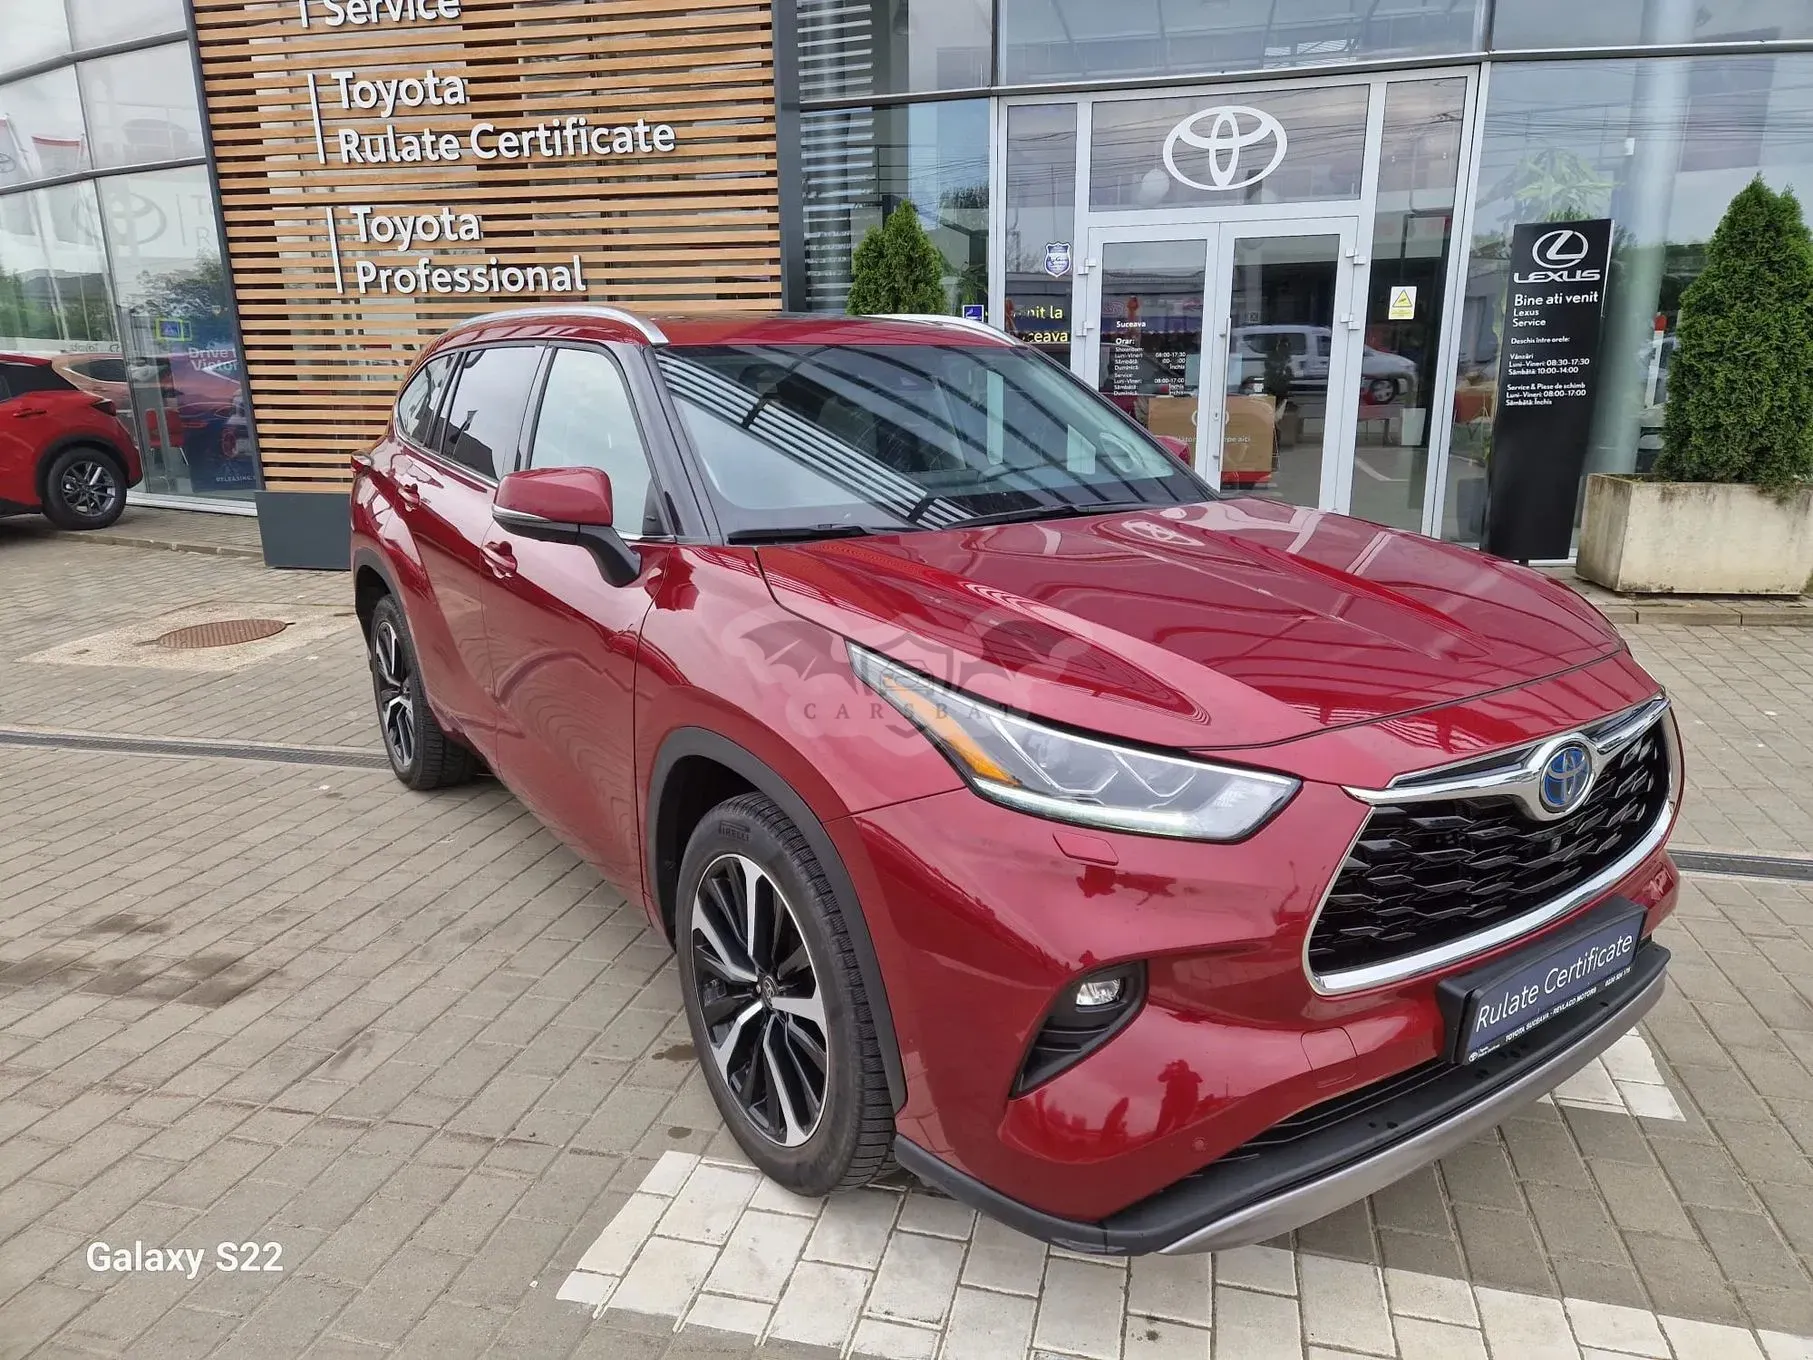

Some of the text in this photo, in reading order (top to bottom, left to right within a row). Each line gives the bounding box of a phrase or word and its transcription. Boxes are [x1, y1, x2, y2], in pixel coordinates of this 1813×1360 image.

[323, 0, 462, 27] Service
[331, 69, 468, 118] Toyota
[338, 116, 676, 164] Rulate Certificate
[349, 206, 482, 252] Toyota
[356, 254, 587, 294] Professional
[1513, 269, 1601, 284] LEXUS
[1514, 293, 1544, 307] Bine
[1565, 290, 1599, 304] venit
[1050, 306, 1063, 319] la
[1513, 307, 1540, 317] Lexus
[1116, 320, 1147, 328] Suceava
[1512, 317, 1546, 328] Service
[1511, 337, 1536, 345] Deschis
[1546, 358, 1590, 367] 08:30-17:30
[1537, 366, 1579, 374] 10:00-14:00
[1507, 383, 1530, 391] Service
[1537, 382, 1554, 390] Piese
[1554, 381, 1563, 390] de
[1563, 381, 1586, 389] schimb
[1543, 389, 1587, 398] 08:00-17:00
[1475, 934, 1632, 1033] Rulate Certificate
